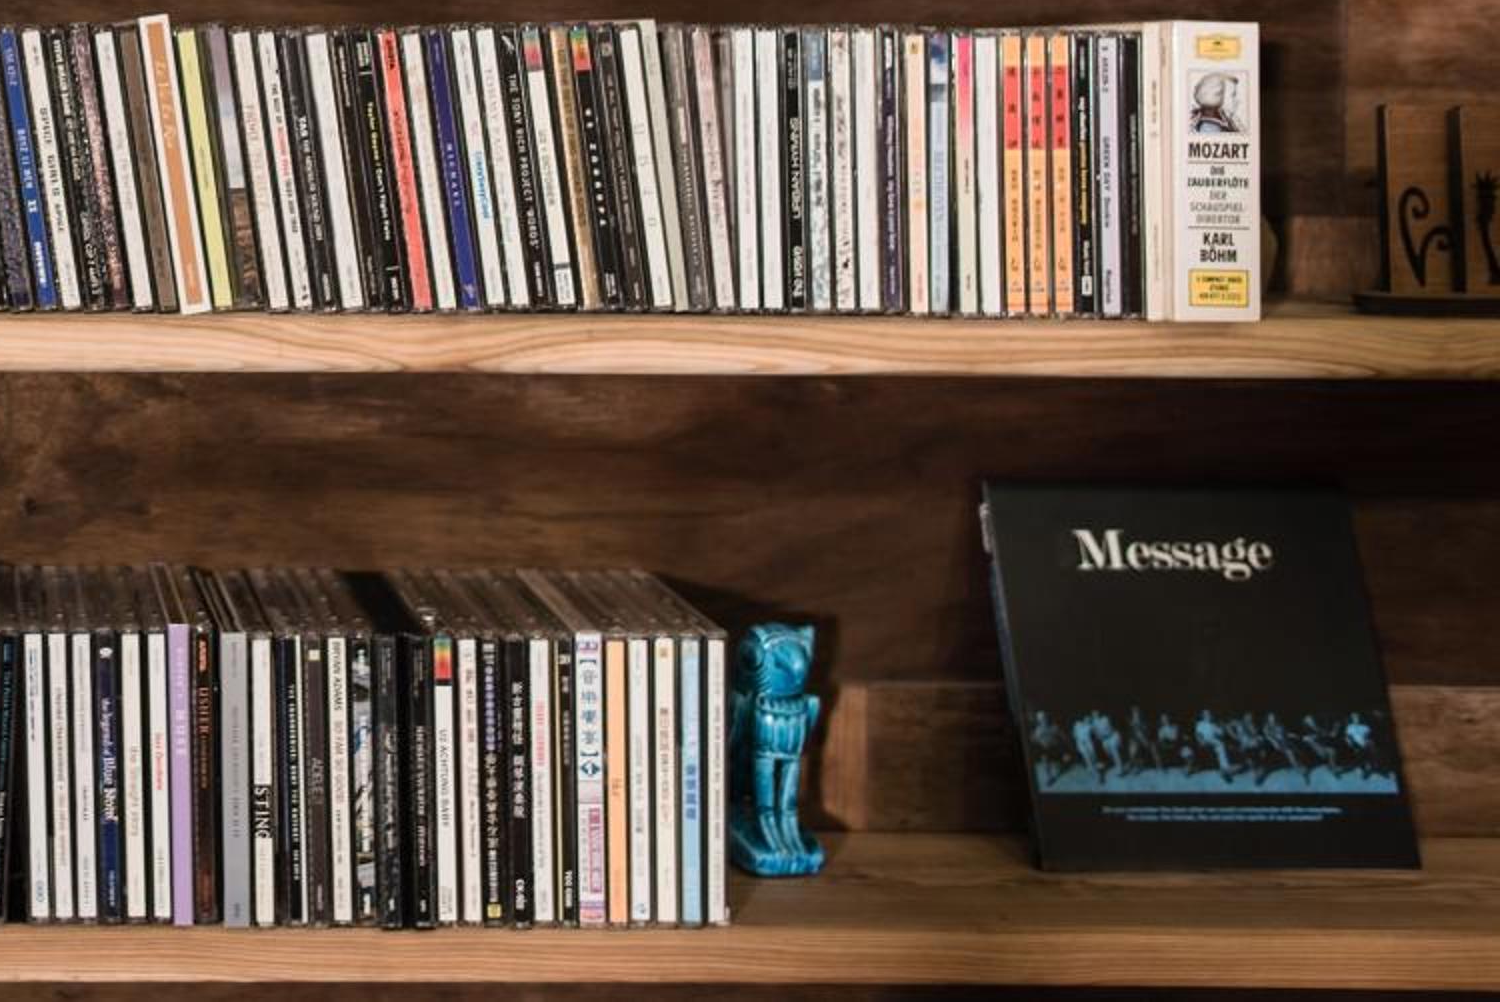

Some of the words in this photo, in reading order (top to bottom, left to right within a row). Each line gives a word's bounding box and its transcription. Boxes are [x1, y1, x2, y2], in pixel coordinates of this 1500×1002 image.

[507, 73, 519, 93] THE
[511, 97, 523, 124] TONY
[1188, 143, 1249, 159] MOZART
[518, 156, 533, 201] PROJECT
[1203, 232, 1235, 247] KARL
[1200, 247, 1237, 262] BÖHM
[1071, 529, 1274, 582] Message
[333, 676, 342, 710] ADAMS
[102, 756, 115, 785] Blue
[310, 757, 324, 793] ADELE
[253, 785, 271, 838] STING
